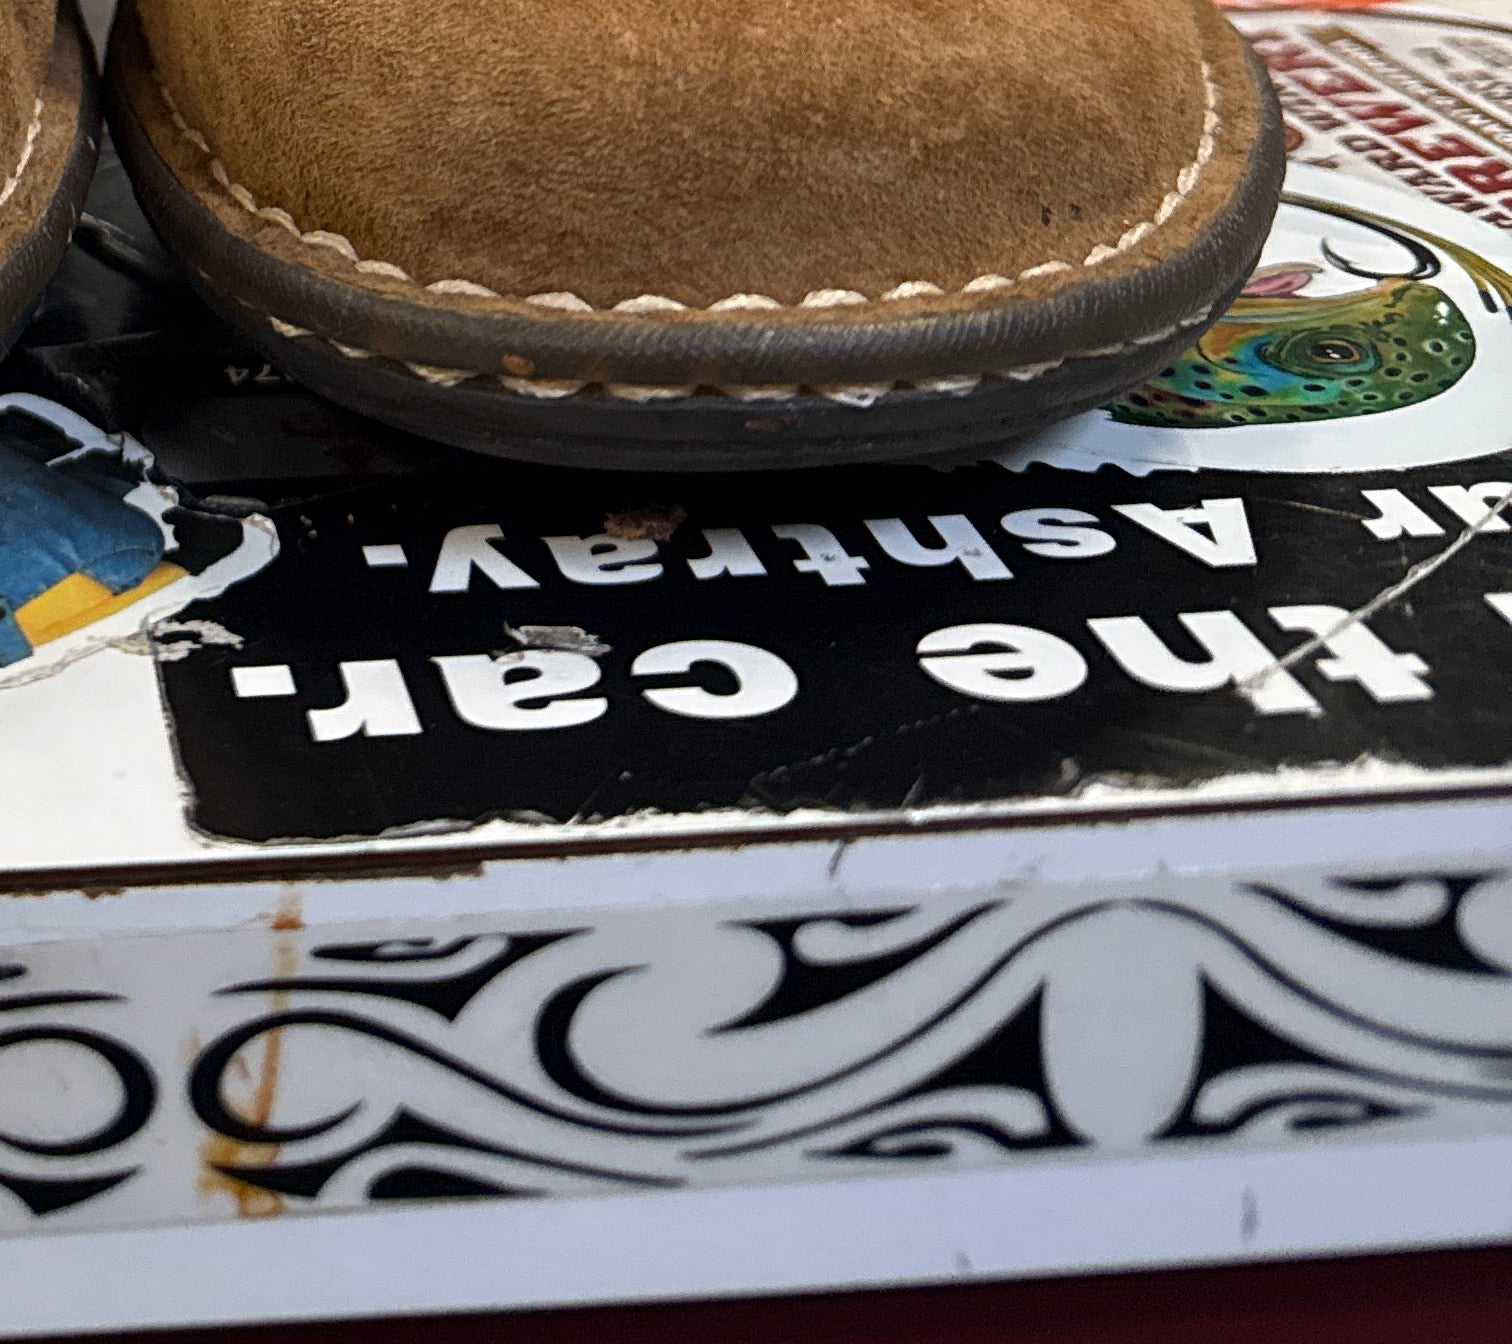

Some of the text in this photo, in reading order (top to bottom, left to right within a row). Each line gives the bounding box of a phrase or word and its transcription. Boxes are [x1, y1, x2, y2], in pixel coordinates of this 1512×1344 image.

[1246, 31, 1512, 210] REWER
[361, 497, 1258, 593] Ashtray.
[231, 605, 1435, 742] the car.
